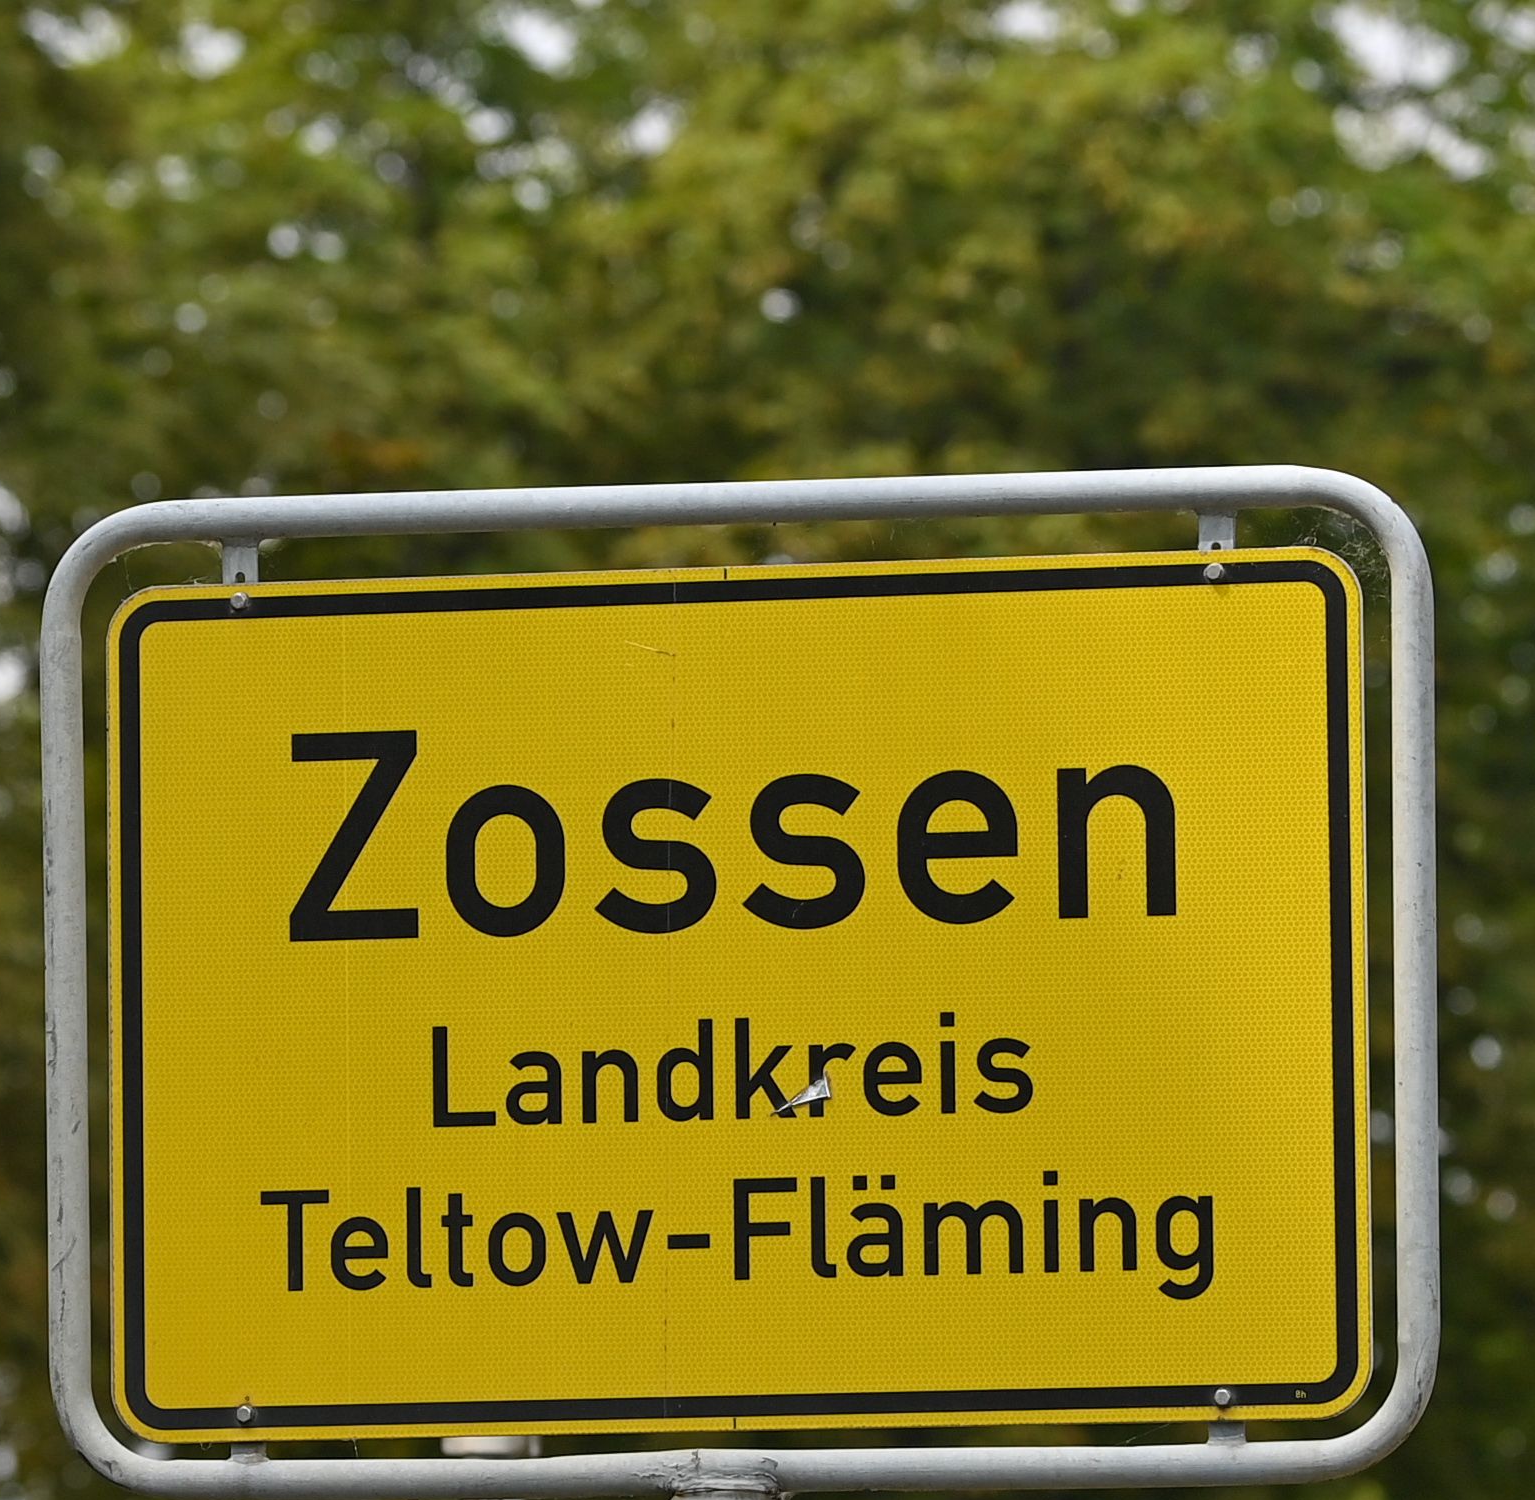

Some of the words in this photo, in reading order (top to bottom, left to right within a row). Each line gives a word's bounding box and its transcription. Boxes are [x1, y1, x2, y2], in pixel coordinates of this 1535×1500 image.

[289, 729, 1177, 943] Zossen
[432, 1011, 1034, 1128] Landkreis
[260, 1170, 1214, 1301] Teltow-Fläming
